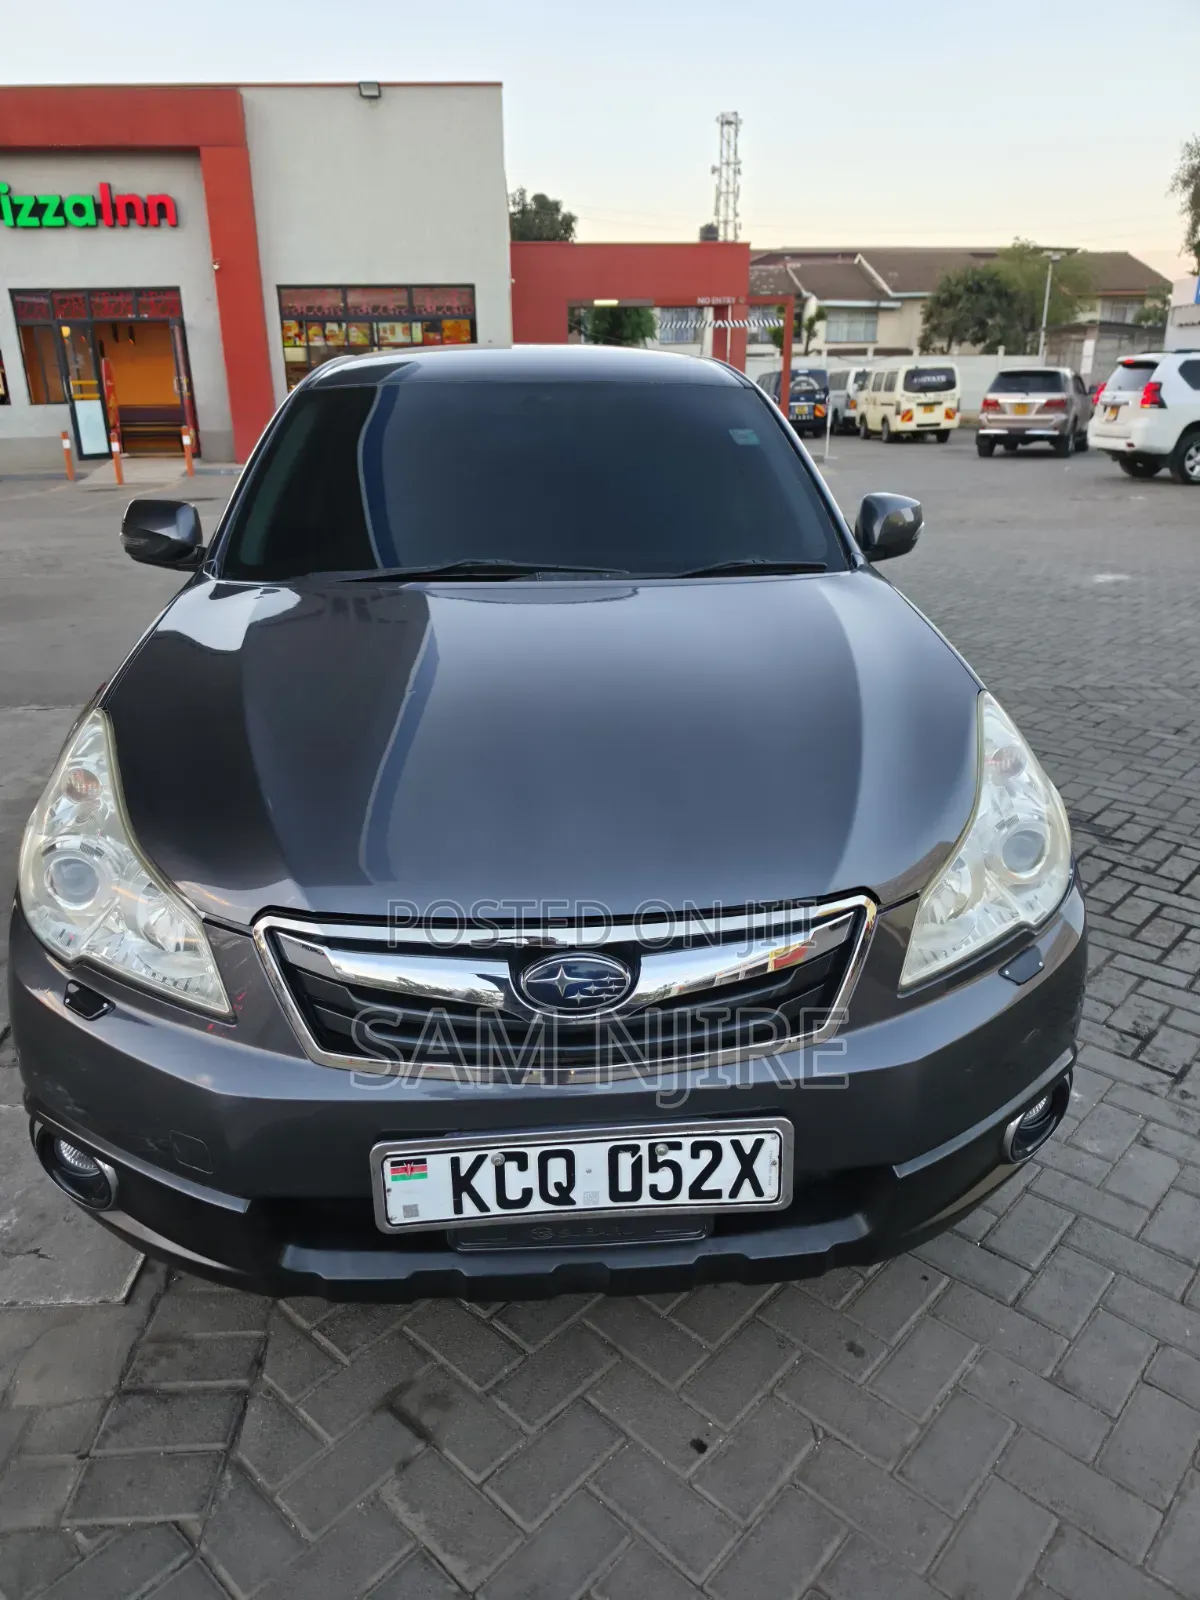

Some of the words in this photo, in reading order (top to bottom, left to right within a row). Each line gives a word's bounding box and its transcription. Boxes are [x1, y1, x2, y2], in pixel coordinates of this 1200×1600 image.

[0, 182, 97, 227] izza
[697, 296, 710, 305] NO
[711, 296, 735, 305] ENTRY
[450, 1150, 577, 1215] KCQ
[608, 1138, 765, 1203] 052X
